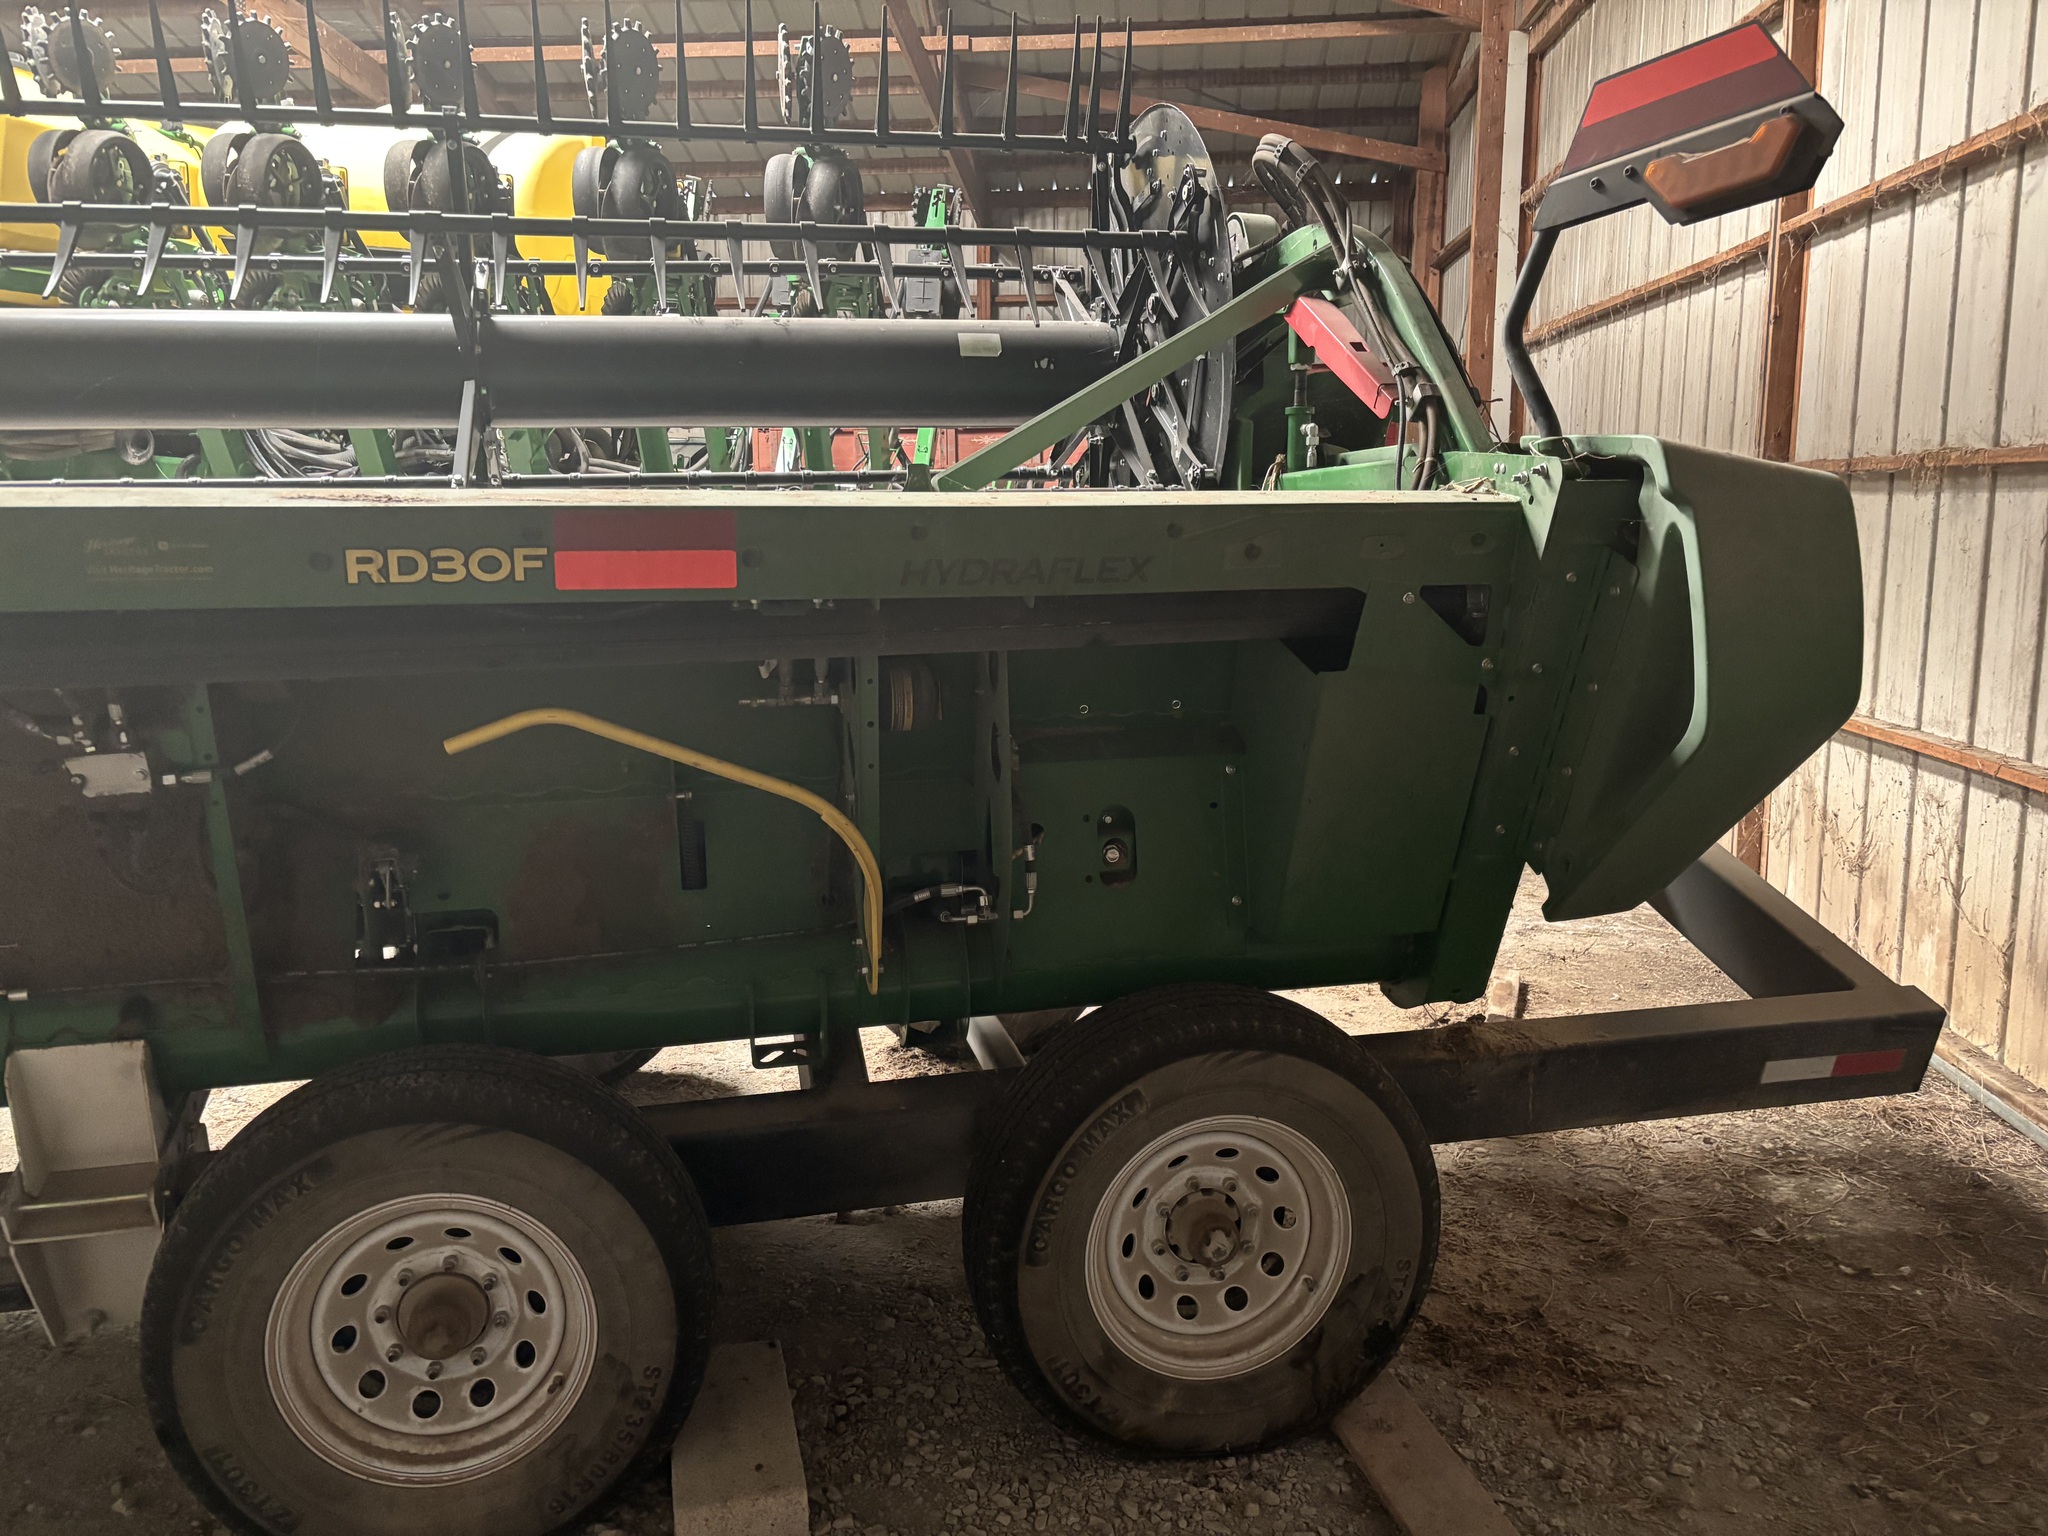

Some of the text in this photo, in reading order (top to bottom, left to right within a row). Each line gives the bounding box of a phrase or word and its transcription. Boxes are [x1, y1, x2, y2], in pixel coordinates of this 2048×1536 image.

[900, 556, 1155, 586] HYDRAFLEX
[1034, 1100, 1133, 1253] CARGO MAX
[188, 1172, 315, 1335] CARGO MAX
